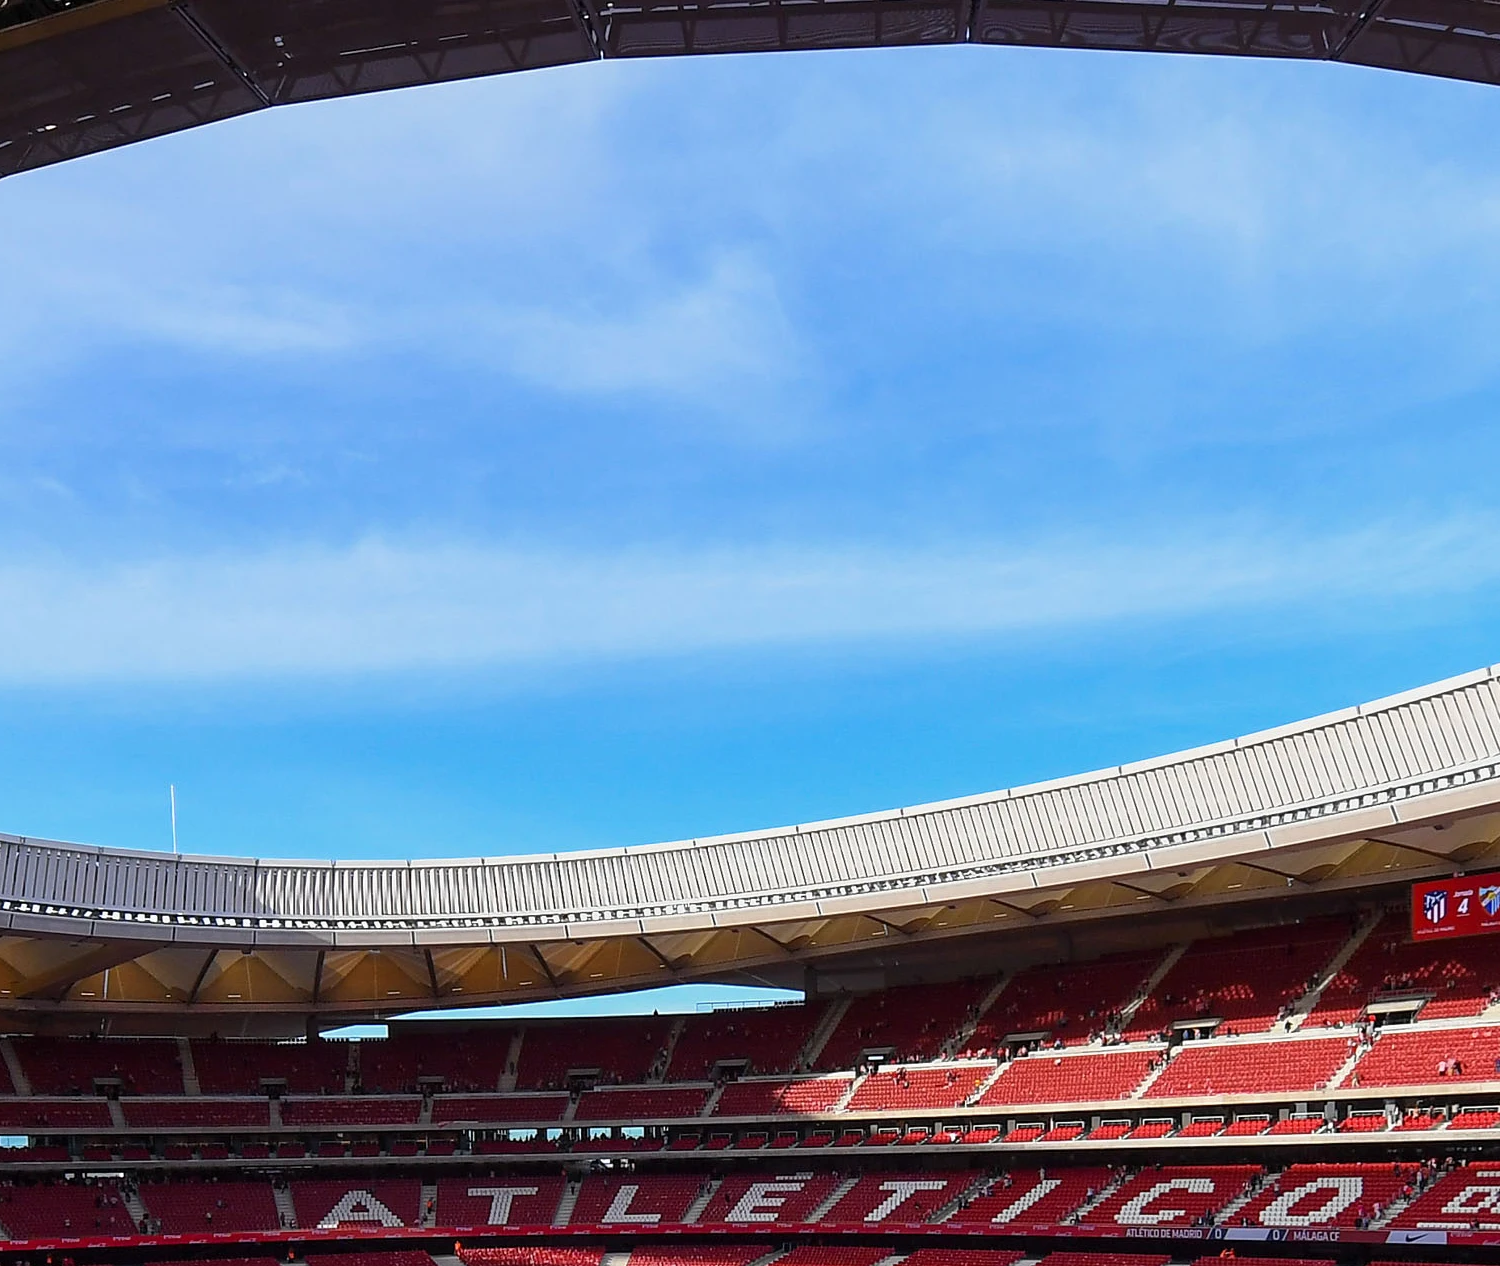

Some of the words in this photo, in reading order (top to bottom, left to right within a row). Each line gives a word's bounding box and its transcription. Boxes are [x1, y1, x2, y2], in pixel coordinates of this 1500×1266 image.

[1457, 898, 1469, 914] 4
[317, 1172, 1363, 1228] ATLÉTICO
[1125, 1227, 1158, 1239] ATLÉTICO
[1159, 1229, 1171, 1239] DE
[1172, 1229, 1203, 1240] MADRID
[1293, 1229, 1329, 1241] MÁLAGA
[1331, 1232, 1340, 1241] CF
